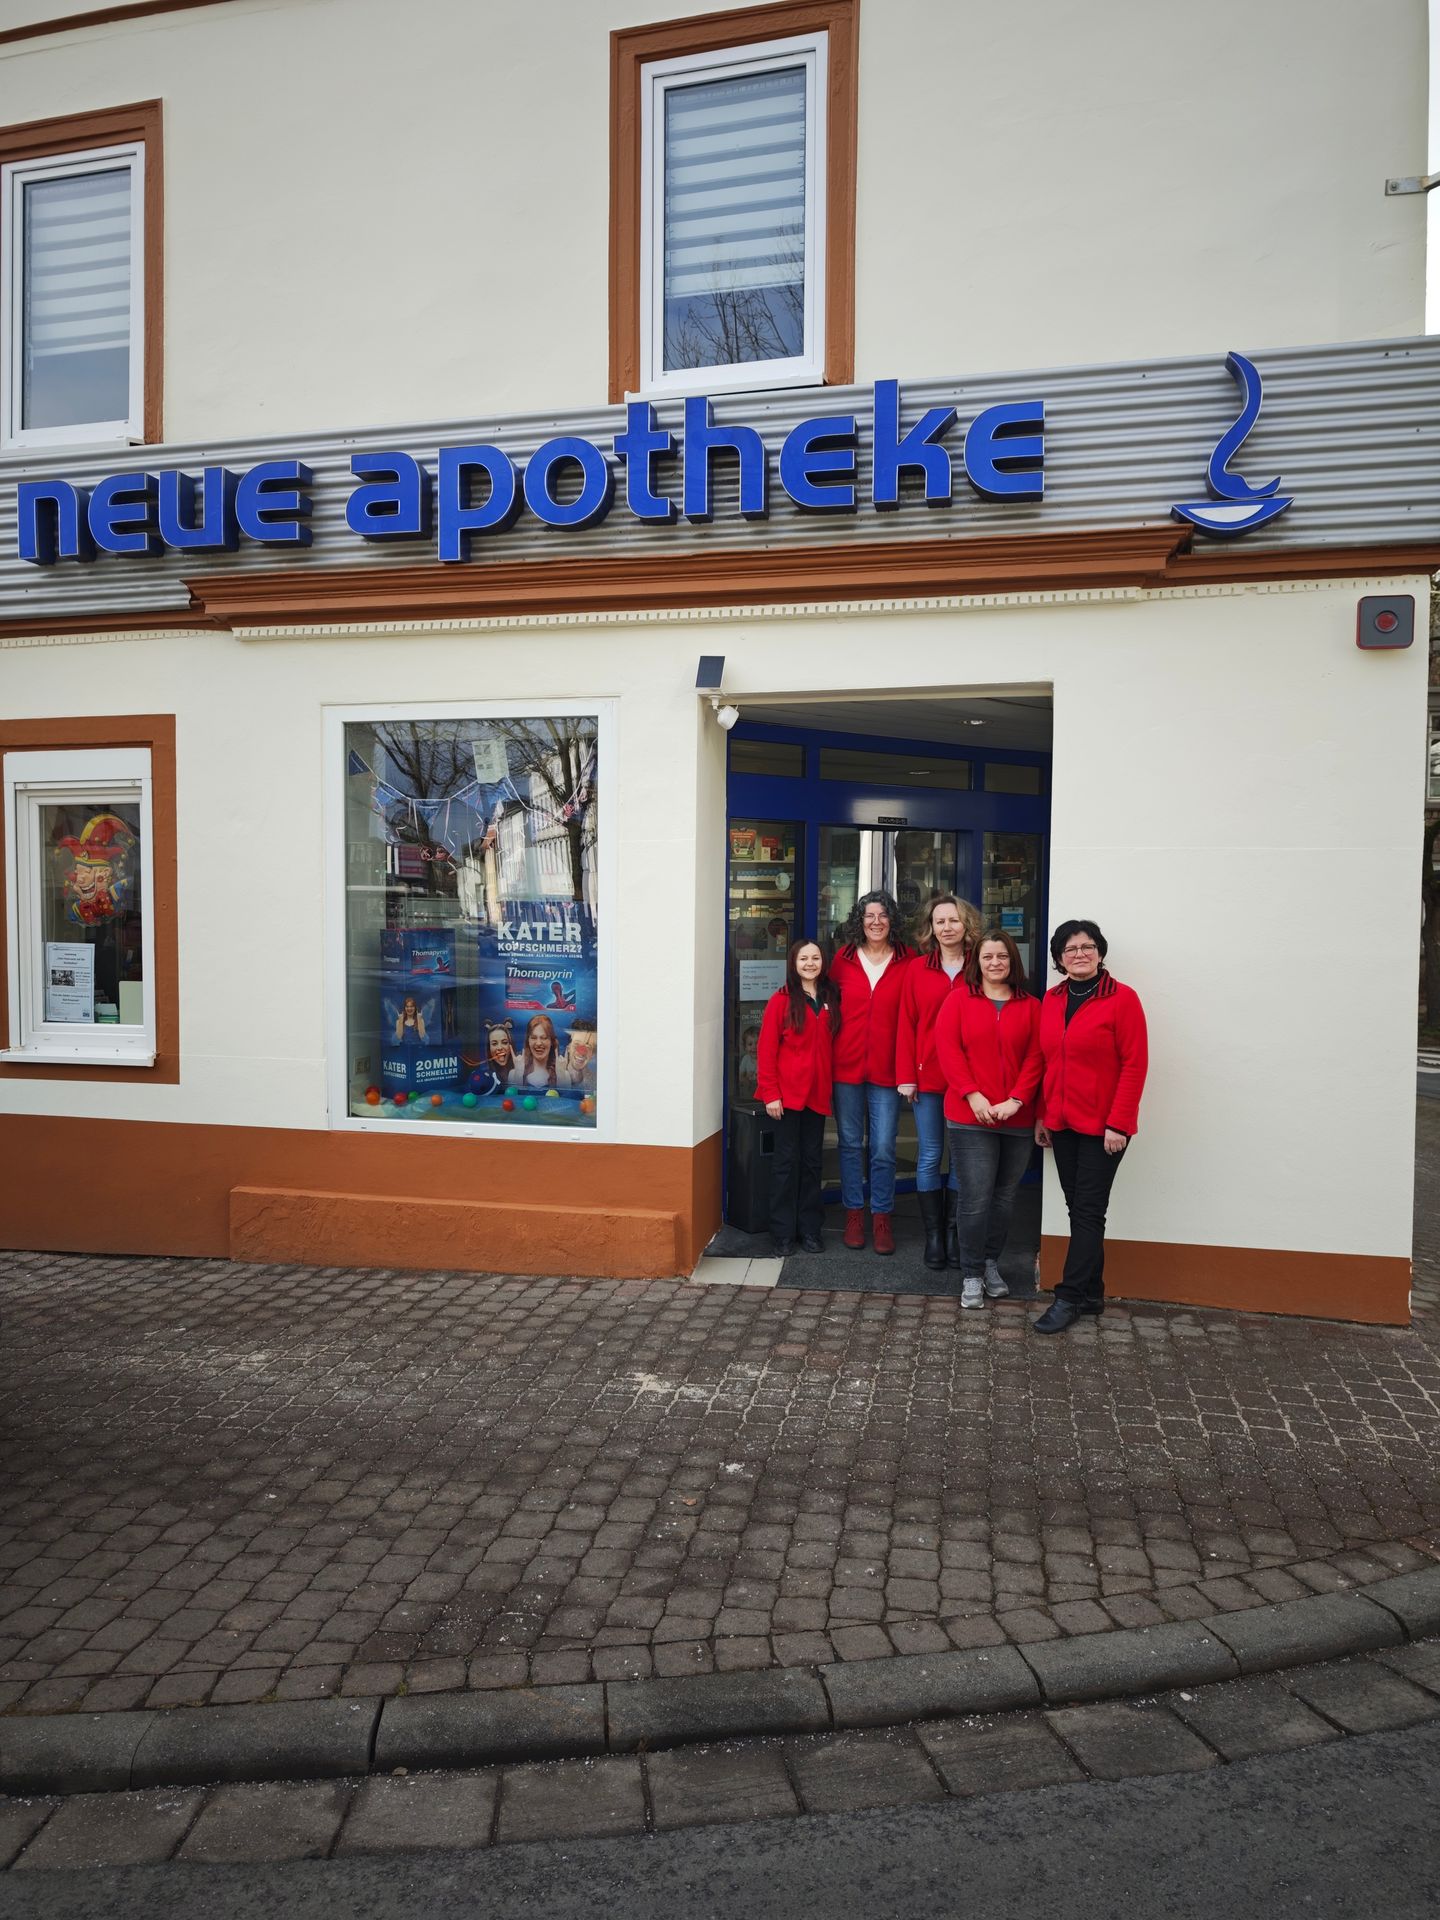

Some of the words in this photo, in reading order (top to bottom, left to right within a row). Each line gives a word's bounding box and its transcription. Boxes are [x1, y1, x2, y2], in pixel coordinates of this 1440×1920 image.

[17, 459, 314, 566] neue
[344, 379, 1045, 564] apotheke
[497, 921, 582, 942] KATER
[498, 942, 582, 953] KOPFSCHMERZ?
[507, 967, 573, 980] Thomapyrin
[383, 1060, 407, 1074] KATER
[416, 1067, 458, 1078] SCHNELLER
